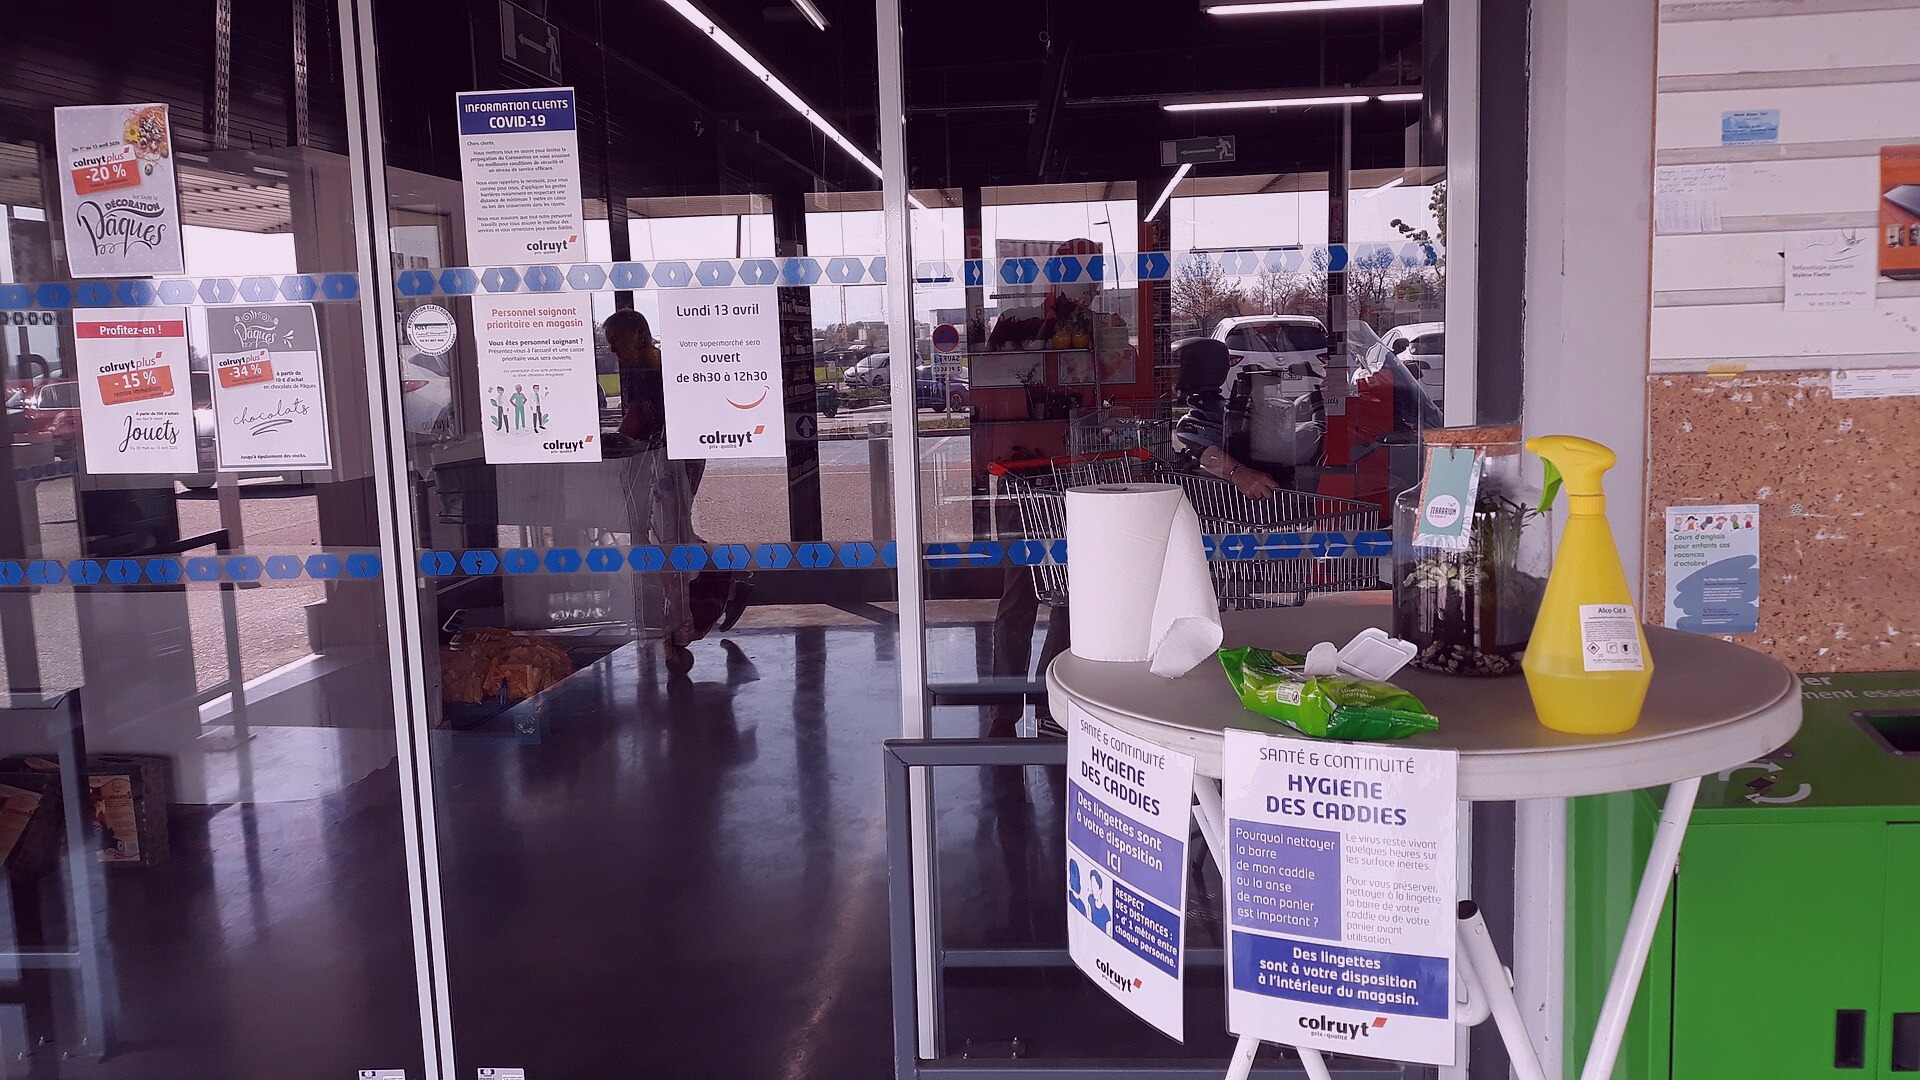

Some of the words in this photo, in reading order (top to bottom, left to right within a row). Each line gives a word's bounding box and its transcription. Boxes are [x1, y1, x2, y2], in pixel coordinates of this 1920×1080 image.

[465, 101, 530, 113] INFORMATION
[532, 99, 569, 110] CLIENTS
[489, 114, 546, 129] COVID-19
[85, 165, 110, 182] -20
[112, 163, 127, 178] %
[104, 198, 160, 211] DÉCORATION
[77, 200, 166, 258] Pâques
[526, 240, 568, 253] colruyt
[491, 308, 536, 317] Personnel
[538, 307, 577, 317] soignant
[676, 305, 711, 317] Lundi
[714, 305, 729, 316] 13
[732, 304, 760, 315] avril
[99, 325, 155, 336] Profitez-en
[157, 325, 162, 335] !
[486, 320, 530, 331] prioritaire
[532, 320, 544, 328] en
[546, 319, 583, 329] magasin
[233, 321, 277, 349] Pâques
[520, 339, 551, 347] personnel
[552, 338, 579, 346] soignant
[679, 340, 698, 348] Votre
[699, 338, 744, 349] supermarché
[700, 352, 741, 363] ouvert
[143, 370, 157, 386] %
[229, 365, 249, 378] -34
[251, 363, 262, 375] %
[676, 372, 689, 383] de
[692, 372, 721, 382] 8h30
[724, 371, 731, 382] à
[734, 371, 768, 382] 12h30
[233, 398, 310, 425] chocolats
[118, 416, 179, 453] Jouets
[699, 431, 753, 447] colruyt
[543, 439, 584, 452] colruyt
[1673, 543, 1689, 551] pour
[1801, 676, 1832, 686] er
[1080, 719, 1101, 742] SANTÉ
[1103, 733, 1109, 745] &
[1110, 737, 1165, 770] CONTINUITÉ
[1092, 746, 1145, 787] HYGIENE
[1259, 746, 1305, 766] SANTÉ
[1309, 752, 1319, 766] &
[1324, 754, 1415, 774] CONTINUITÉ
[1081, 760, 1101, 786] DES
[1104, 776, 1160, 816] CADDIES
[1287, 774, 1383, 800] HYGIENE
[1266, 795, 1306, 816] DES
[1312, 800, 1407, 827] CADDIES
[1077, 791, 1092, 812] Des
[1093, 803, 1135, 838] lingettes
[1136, 830, 1162, 852] sont
[1076, 808, 1082, 823] à
[1083, 818, 1105, 839] votre
[1106, 830, 1163, 872] disposition
[1235, 827, 1284, 845] Pourquoi
[1286, 835, 1336, 852] nettoyer
[1345, 833, 1356, 843] Le
[1358, 834, 1381, 846] virus
[1382, 836, 1406, 848] reste
[1408, 838, 1437, 850] vivant
[1236, 843, 1246, 855] la
[1248, 842, 1277, 859] barre
[1345, 844, 1387, 857] quelques
[1389, 846, 1421, 859] heures
[1423, 850, 1438, 861] sur
[1106, 850, 1121, 874] ICI
[1236, 859, 1250, 871] de
[1252, 862, 1276, 875] mon
[1278, 864, 1316, 881] caddie
[1345, 855, 1360, 865] les
[1361, 856, 1395, 869] surface
[1396, 858, 1432, 871] inertes.
[1236, 876, 1250, 887] ou
[1252, 876, 1263, 888] la
[1265, 881, 1292, 893] anse
[1346, 875, 1366, 886] Pour
[1368, 879, 1391, 890] vous
[1393, 880, 1439, 894] préserver,
[1115, 886, 1144, 912] RESPECT
[1237, 891, 1250, 902] de
[1252, 894, 1276, 906] mon
[1279, 898, 1315, 912] panier
[1346, 888, 1385, 900] nettoyer
[1388, 888, 1394, 901] à
[1395, 890, 1404, 901] la
[1405, 891, 1442, 906] lingette
[1346, 898, 1355, 908] la
[1357, 899, 1380, 911] barre
[1382, 900, 1394, 911] de
[1396, 902, 1420, 914] votre
[1115, 899, 1128, 916] DES
[1129, 907, 1169, 941] DISTANCES
[1237, 907, 1254, 919] est
[1256, 908, 1311, 928] important
[1313, 916, 1319, 928] ?
[1346, 909, 1377, 921] caddie
[1378, 912, 1390, 922] ou
[1391, 911, 1404, 924] de
[1405, 915, 1430, 927] votre
[1346, 921, 1374, 934] panier
[1376, 924, 1403, 935] avant
[1115, 924, 1139, 946] chaque
[1140, 941, 1176, 969] personne.
[1128, 921, 1133, 930] 1
[1134, 925, 1156, 945] mètre
[1157, 938, 1177, 956] entre
[1346, 932, 1392, 946] utilisation.
[1292, 946, 1318, 962] Des
[1321, 949, 1381, 971] lingettes
[1095, 958, 1132, 993] colruyt
[1259, 958, 1288, 973] sont
[1291, 961, 1300, 974] à
[1303, 964, 1338, 981] votre
[1341, 969, 1417, 990] disposition
[1258, 972, 1266, 985] à
[1269, 974, 1334, 996] l'intérieur
[1336, 985, 1354, 998] du
[1357, 990, 1419, 1007] magasin.
[1298, 1014, 1369, 1040] colruyt
[1310, 1030, 1323, 1039] prix
[1326, 1032, 1348, 1041] qualité
